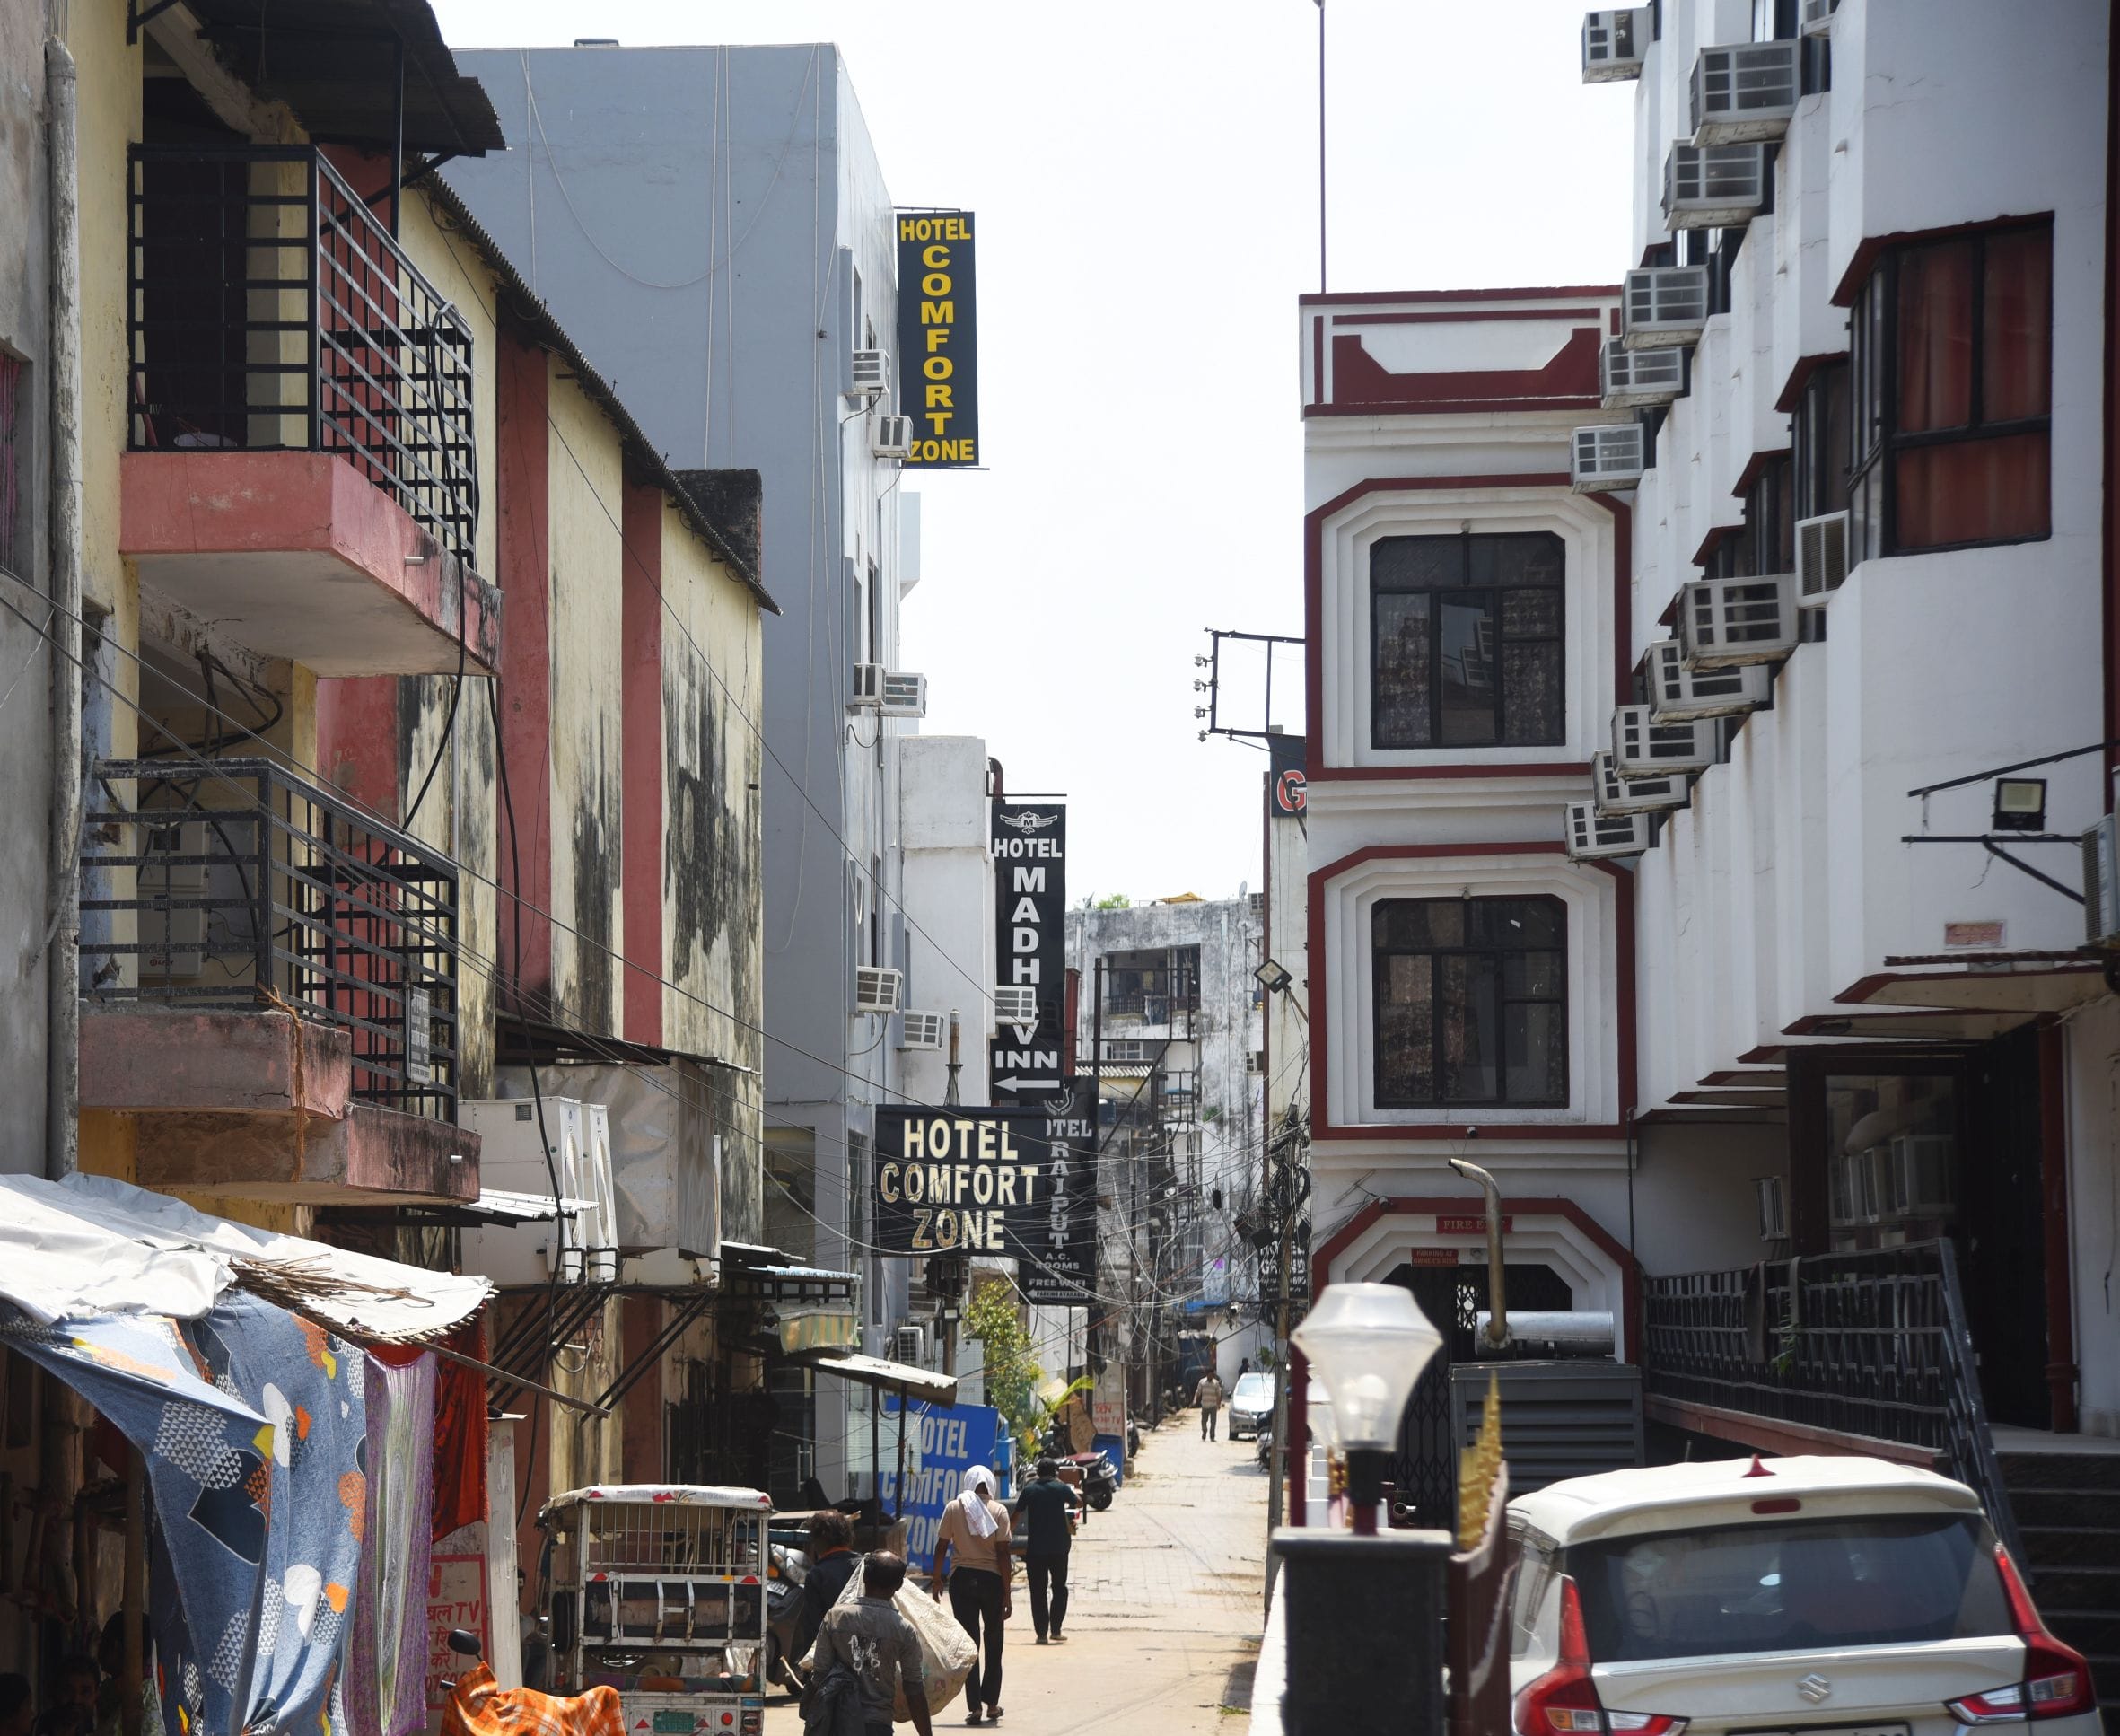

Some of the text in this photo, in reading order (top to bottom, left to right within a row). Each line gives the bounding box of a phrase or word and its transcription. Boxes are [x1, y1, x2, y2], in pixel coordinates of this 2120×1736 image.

[900, 218, 971, 241] HOTEL
[921, 245, 954, 435] COMFORT
[906, 439, 975, 462] ZONE
[994, 838, 1063, 858] HOTEL
[1011, 866, 1046, 1045] MADHV
[995, 1050, 1058, 1069] INN
[1046, 1118, 1092, 1137] TEL
[904, 1118, 1019, 1161] HOTEL
[880, 1162, 1039, 1206] COMFORT
[1049, 1141, 1070, 1249] RAJPUT
[911, 1208, 1005, 1249] ZONE
[1443, 1220, 1473, 1230] FIRE
[1045, 1252, 1070, 1260] A.C.
[1029, 1278, 1056, 1286] FREE
[921, 1416, 968, 1460] OTEL
[455, 1600, 480, 1624] TV
